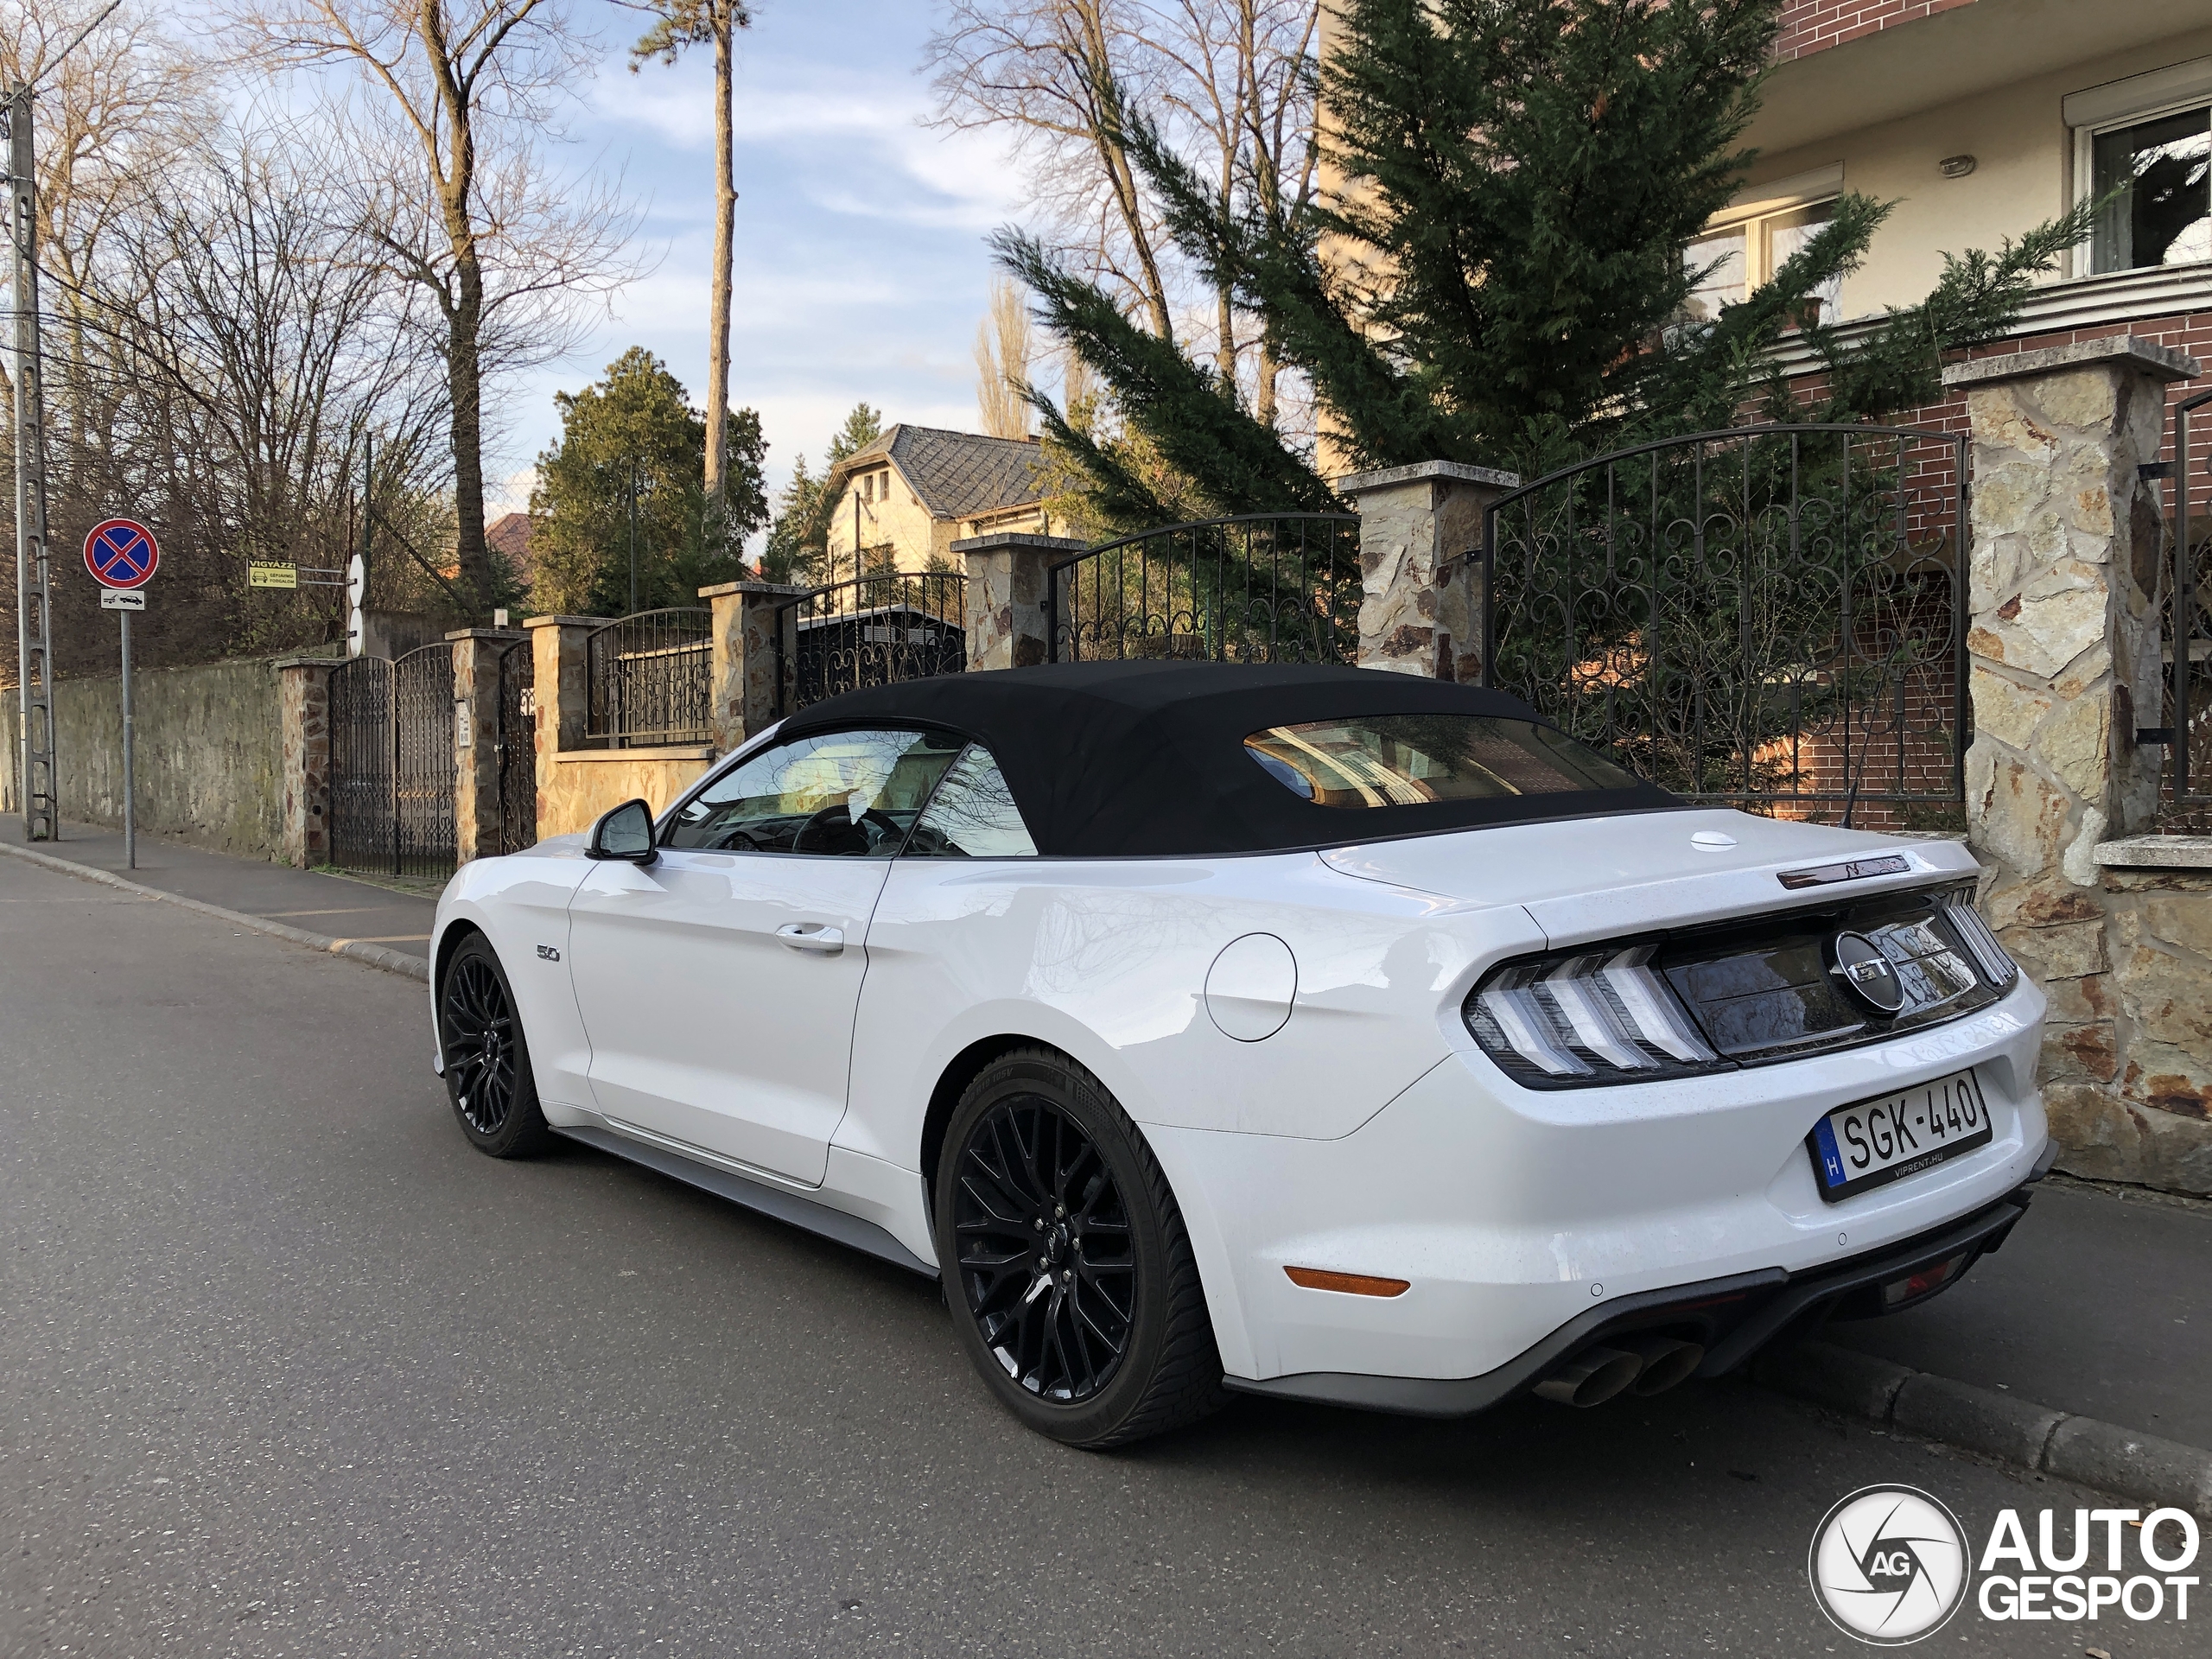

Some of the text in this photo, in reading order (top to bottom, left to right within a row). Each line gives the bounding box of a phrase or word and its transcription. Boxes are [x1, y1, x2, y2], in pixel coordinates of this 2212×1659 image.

[249, 560, 296, 569] VIGYÁZZ!
[1848, 957, 1887, 982] GT
[1844, 1079, 1978, 1169] SGK-440
[1827, 1156, 1840, 1177] H
[1894, 1153, 1943, 1178] VIPRENT.HU
